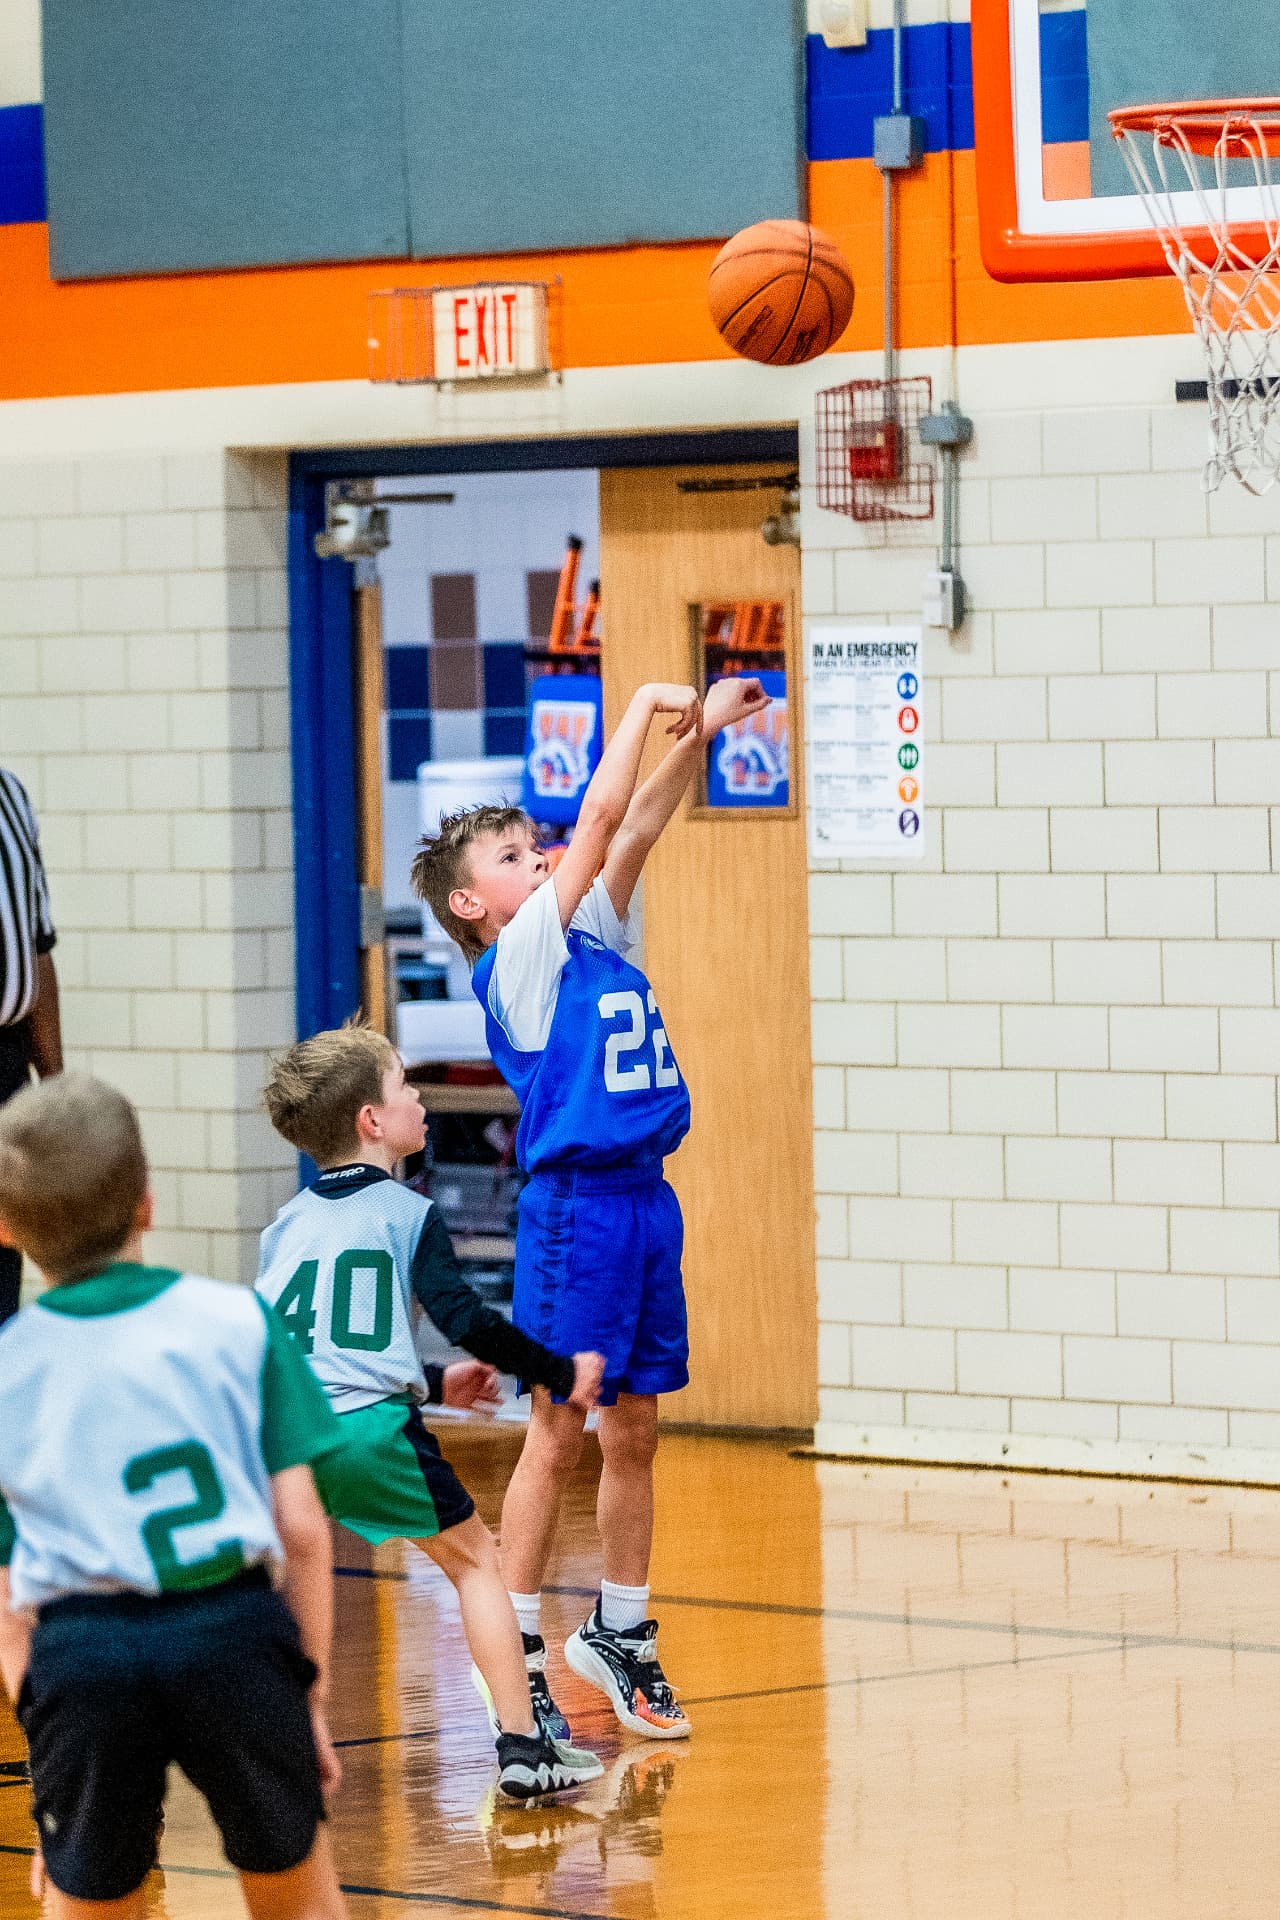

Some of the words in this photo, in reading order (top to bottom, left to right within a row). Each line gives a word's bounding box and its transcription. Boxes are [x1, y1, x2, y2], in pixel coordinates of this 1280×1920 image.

[454, 294, 517, 367] EXIT
[813, 643, 823, 657] IN
[827, 643, 842, 657] AN
[847, 641, 917, 657] EMERGENCY
[598, 989, 679, 1092] 22
[273, 1248, 394, 1354] 40
[122, 1437, 243, 1591] 2
